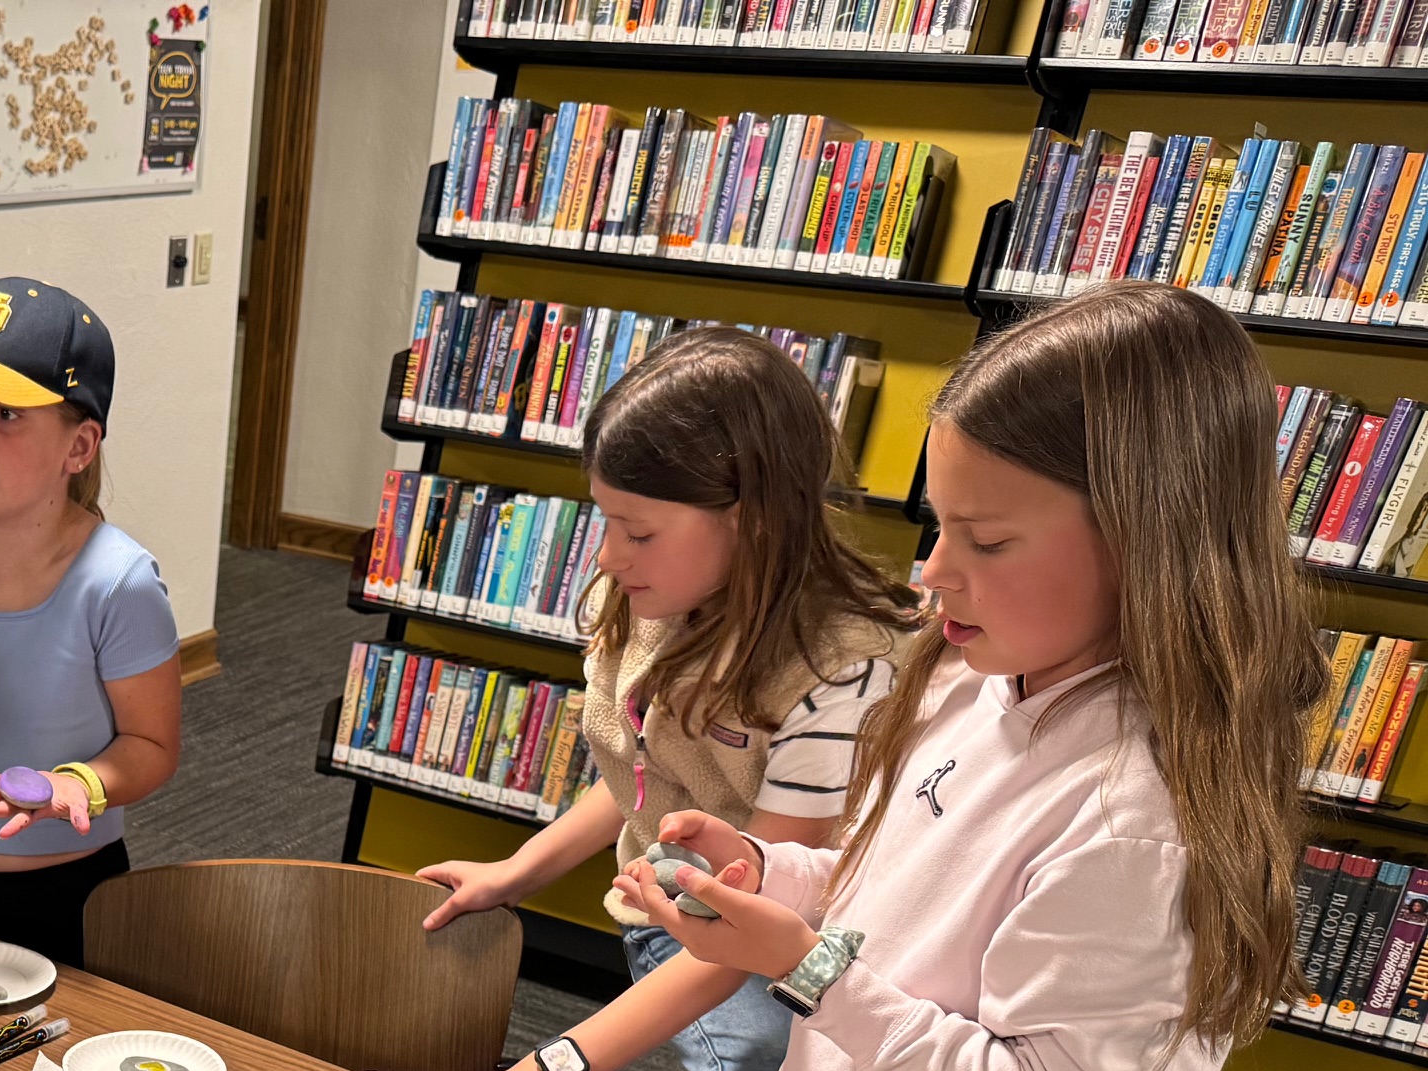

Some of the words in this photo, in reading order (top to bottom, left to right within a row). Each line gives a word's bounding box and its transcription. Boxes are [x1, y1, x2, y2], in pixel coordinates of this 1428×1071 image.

[159, 74, 190, 89] NIGHT
[490, 145, 504, 176] RAIN
[631, 150, 649, 195] PROJECT
[781, 142, 794, 179] GRACE
[1124, 154, 1143, 175] THE
[754, 166, 771, 201] ISLANDS
[774, 186, 784, 206] WILD
[1179, 182, 1194, 200] THE
[1269, 166, 1286, 200] MILES
[803, 176, 830, 240] BENCHWARMERS
[839, 191, 856, 238] COVER-UP
[856, 192, 869, 217] LAST
[889, 196, 898, 214] RUSH
[1052, 182, 1072, 229] GRACEFULLY
[1090, 188, 1111, 224] CITY
[1105, 177, 1135, 238] BEWITCHING
[1225, 195, 1239, 221] LOOK
[1244, 190, 1262, 212] LU
[1328, 186, 1356, 232] TREASURE
[822, 196, 839, 242] CHANGE-UP
[850, 218, 863, 241] SHOT
[879, 225, 893, 246] GOLD
[896, 195, 914, 242] VANISHING
[1163, 200, 1190, 254] RHYTHM
[1188, 203, 1207, 246] GHOST
[1203, 204, 1222, 247] GHOST
[1251, 200, 1276, 248] MORALES
[1269, 209, 1294, 258] PATINA
[1287, 193, 1313, 245] SUNNY
[1313, 215, 1325, 233] BLACK
[1384, 213, 1400, 234] STU
[892, 243, 903, 256] ACT
[1076, 226, 1100, 267] SPIES
[1316, 231, 1340, 271] ISLAND
[1374, 233, 1393, 266] TRULY
[1396, 242, 1413, 267] FIRST
[65, 368, 79, 388] Z
[407, 353, 420, 369] BIG
[580, 338, 600, 400] GREEN
[526, 382, 545, 419] DUNKIN
[1292, 430, 1314, 471] LEGEND
[1310, 457, 1325, 473] AM
[1303, 471, 1320, 494] THE
[1332, 478, 1353, 513] counting
[1325, 508, 1338, 526] by
[1378, 476, 1410, 530] FLYGIRL
[570, 514, 587, 566] SKATING
[562, 566, 573, 585] ON
[1359, 685, 1375, 716] Before
[1373, 689, 1391, 721] Harbor
[1387, 690, 1411, 738] FRONT
[1346, 728, 1359, 751] Ever
[1368, 717, 1381, 736] Me
[1337, 749, 1352, 771] After
[1369, 744, 1391, 780] DESK
[1320, 892, 1348, 940] BLOOD
[1325, 911, 1358, 973] CHILDREN
[1358, 926, 1386, 983] CHILDREN
[1397, 941, 1416, 971] THERE
[1369, 936, 1407, 1010] NEIGHBORHOOD
[1389, 969, 1405, 991] GOES
[1342, 1001, 1350, 1011] 2
[1382, 990, 1398, 1010] THE
